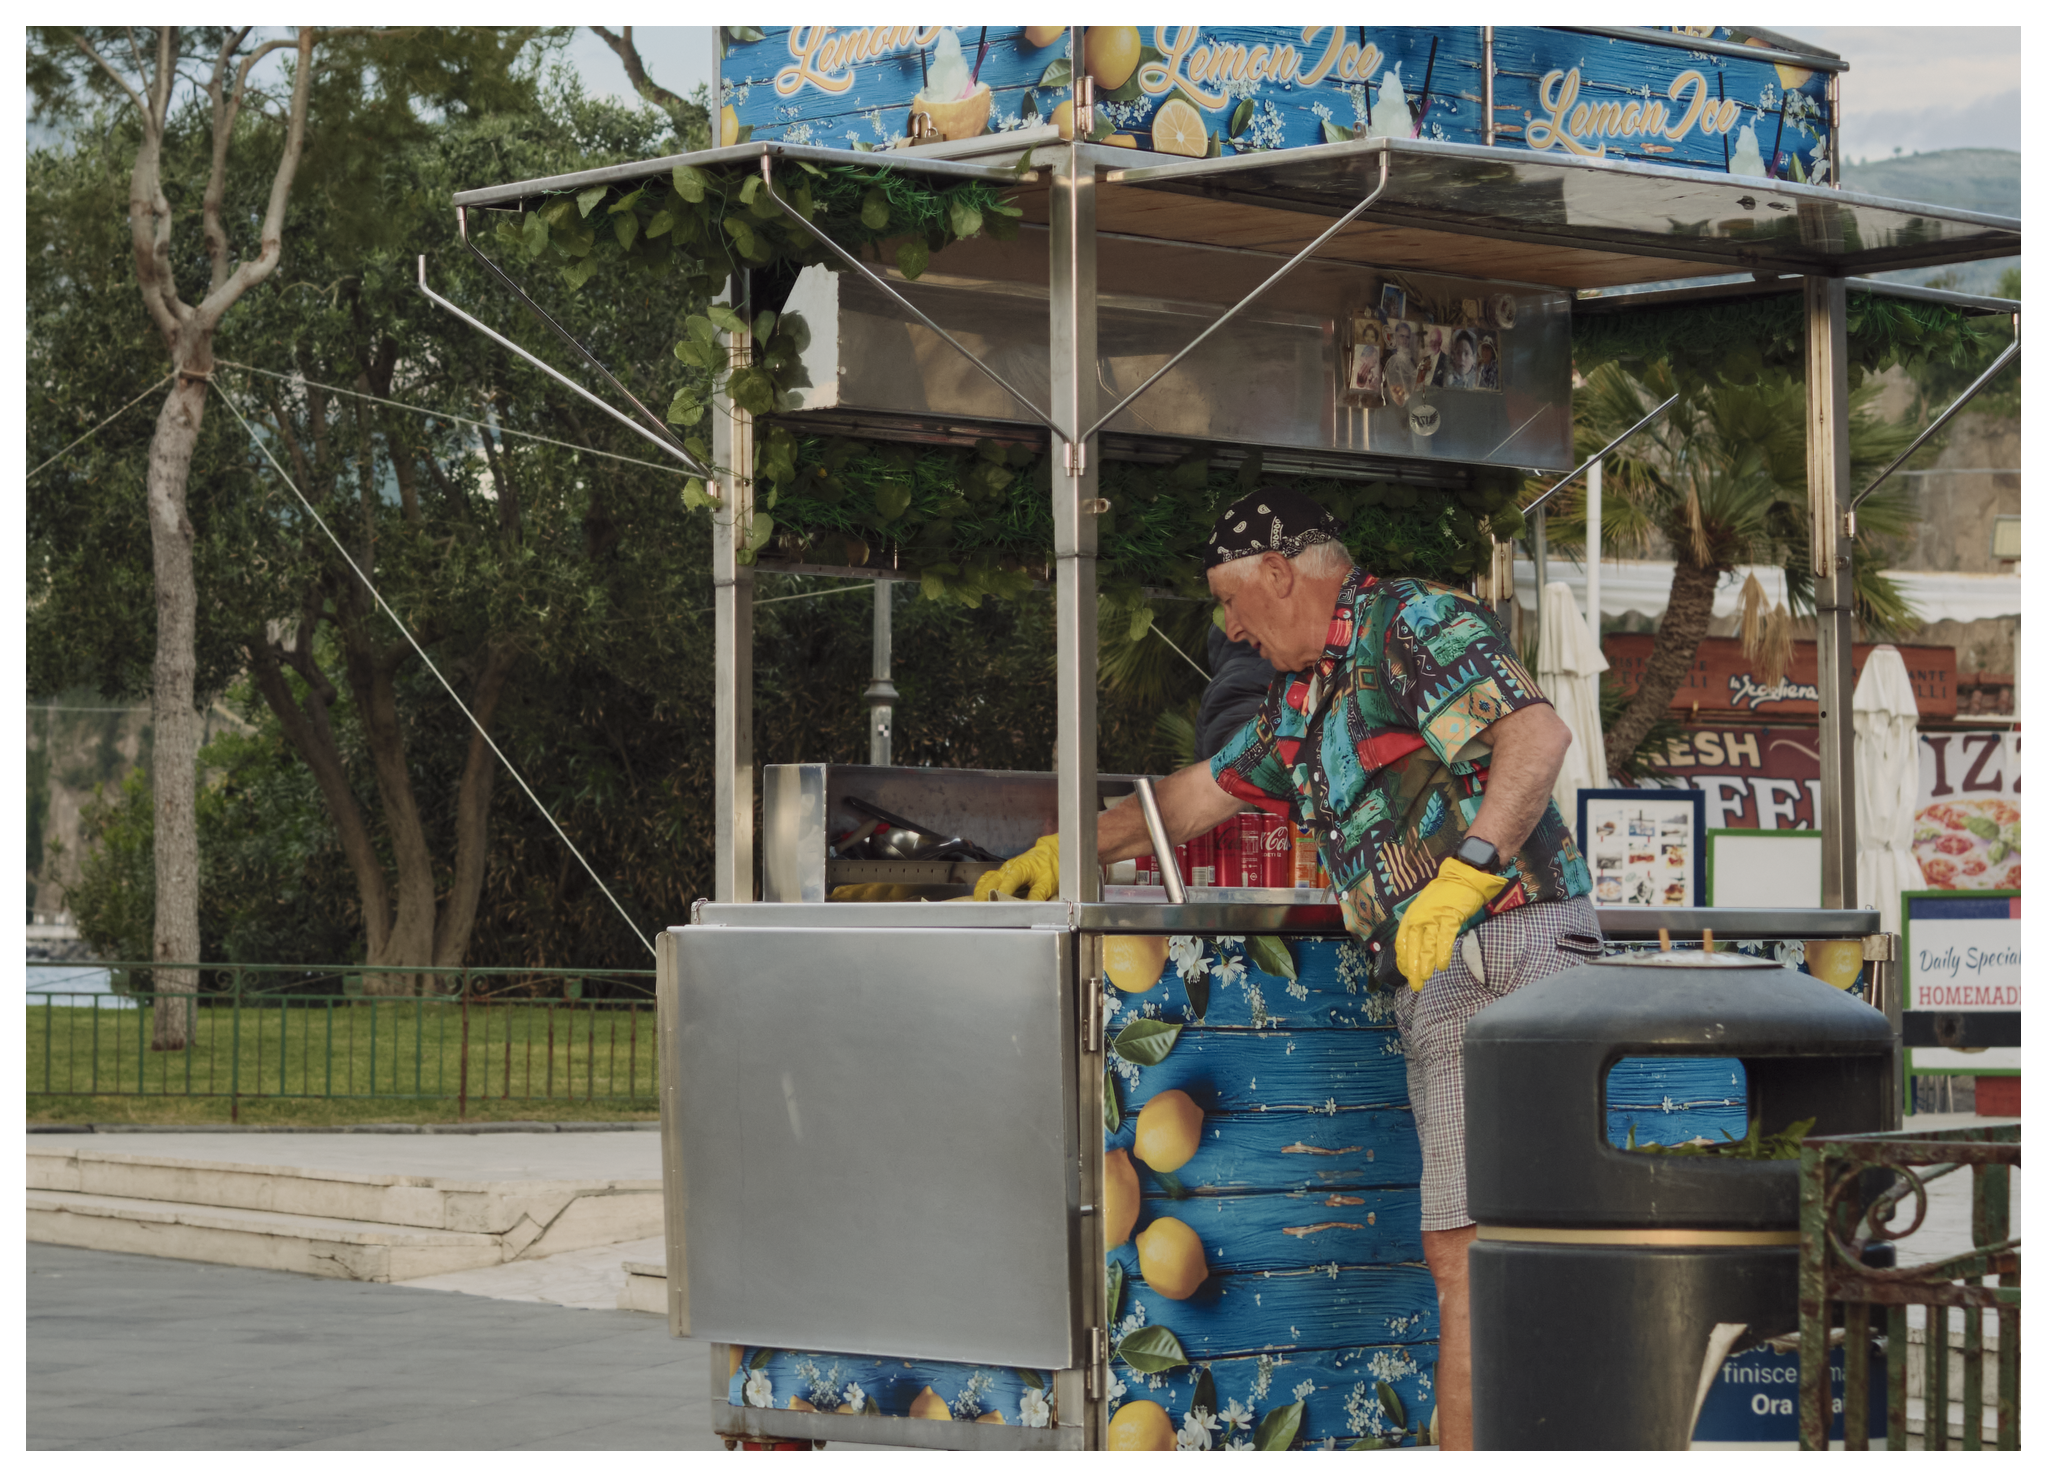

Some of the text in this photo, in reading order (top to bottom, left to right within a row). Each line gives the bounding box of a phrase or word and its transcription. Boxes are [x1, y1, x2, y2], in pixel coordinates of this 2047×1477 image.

[1140, 26, 1384, 109] Lemon Ice
[1527, 68, 1740, 157] Lemon Ice
[1919, 946, 1961, 978] Daily
[1919, 985, 2021, 1006] HOMEMAD
[1722, 1362, 1798, 1384] finisce
[1751, 1393, 1793, 1415] Ora
